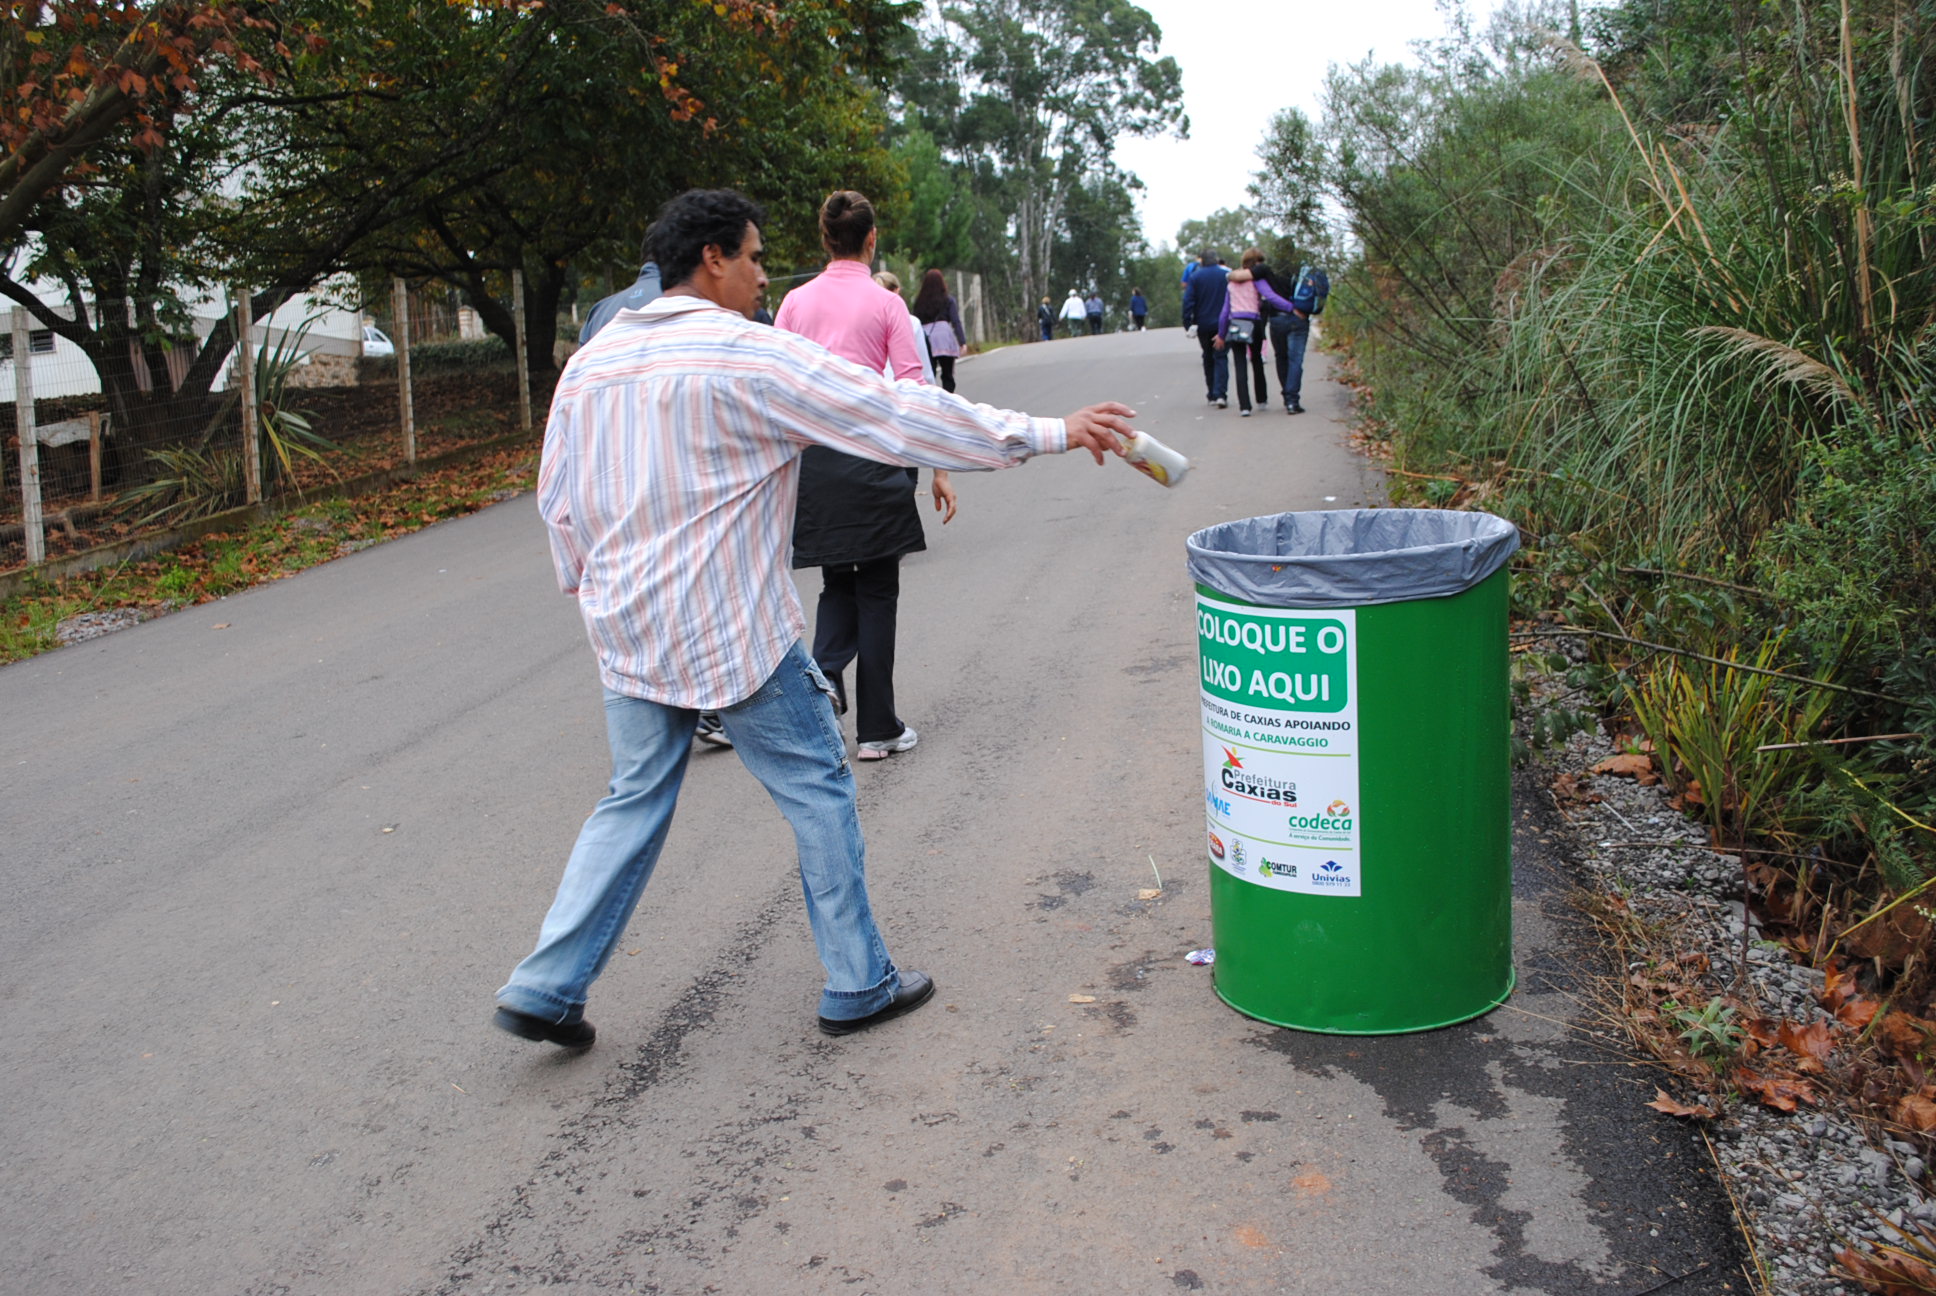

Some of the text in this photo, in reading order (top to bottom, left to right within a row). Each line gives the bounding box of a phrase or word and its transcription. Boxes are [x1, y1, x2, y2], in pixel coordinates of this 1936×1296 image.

[1198, 609, 1345, 655] COLOQUE O
[1203, 655, 1329, 704] LIXO AQUI
[1230, 710, 1242, 721] DE
[1244, 713, 1281, 728] CAXIAS
[1284, 719, 1351, 731] APOIANDO
[1253, 732, 1328, 748] CARAVAGGIO
[1221, 768, 1297, 802] Caxias
[1234, 769, 1297, 791] Prefeitura
[1288, 812, 1353, 830] codeca
[1266, 861, 1297, 874] COMTUR
[1312, 873, 1351, 882] Univias
